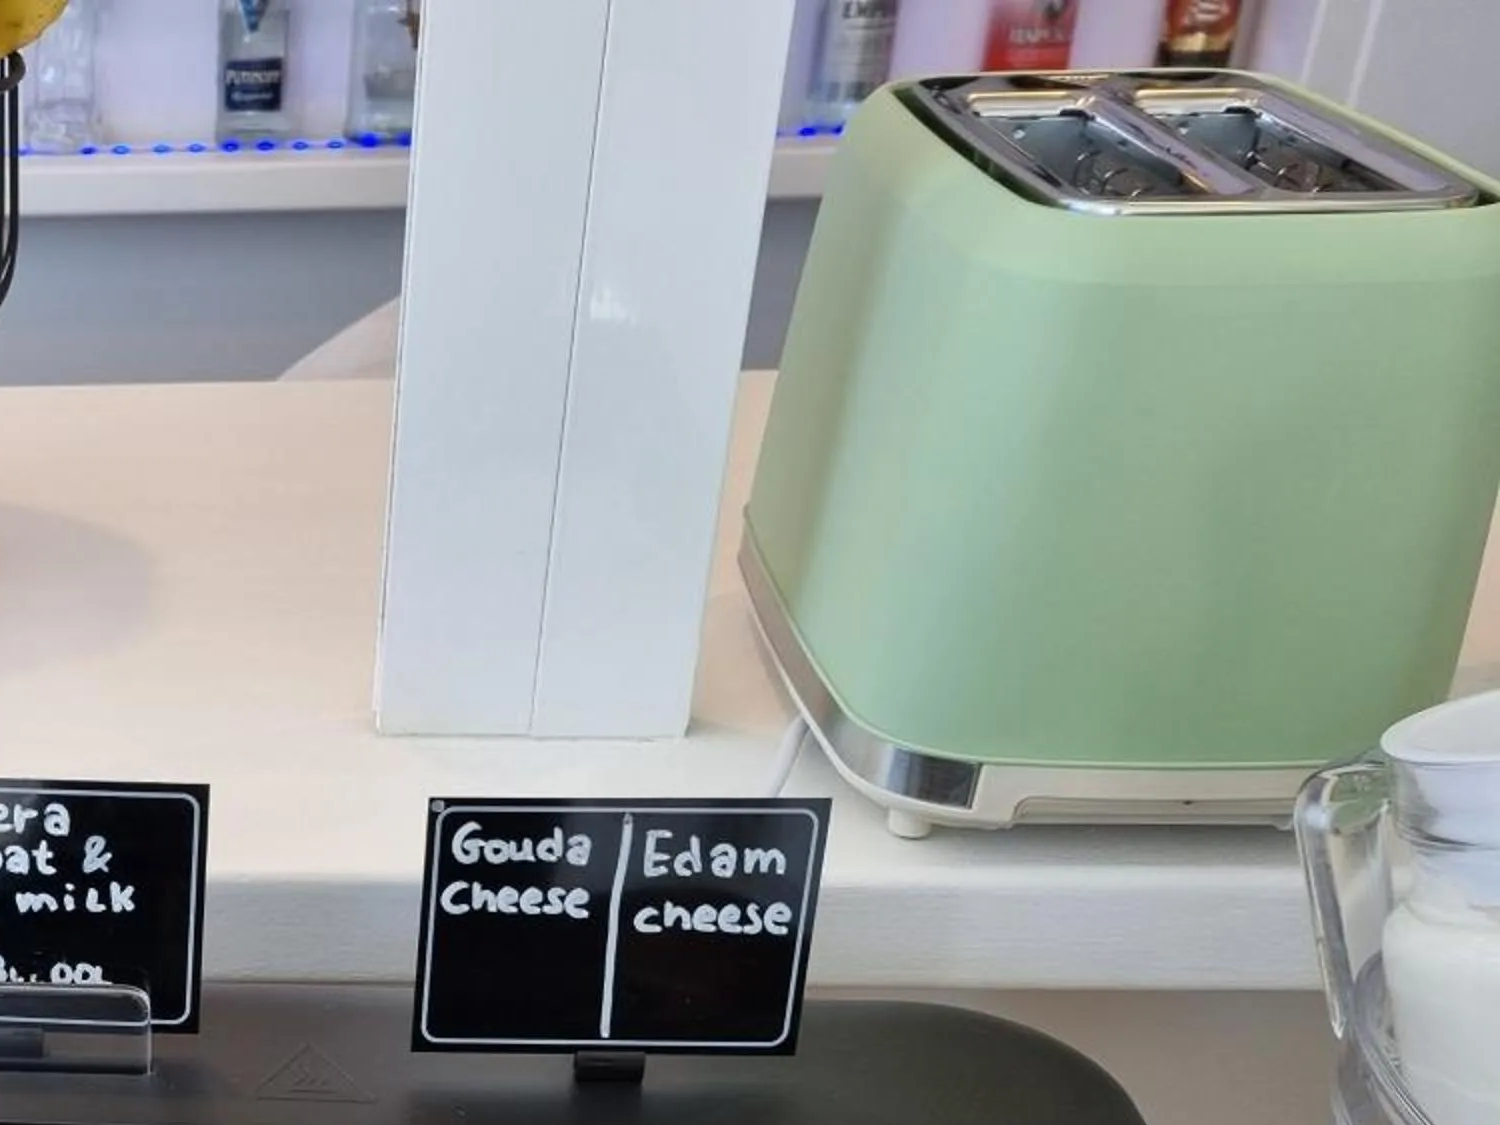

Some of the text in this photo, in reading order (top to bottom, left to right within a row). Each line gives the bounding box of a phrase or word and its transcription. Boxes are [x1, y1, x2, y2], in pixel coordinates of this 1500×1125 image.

[83, 835, 113, 874] &
[451, 821, 592, 867] Gouda
[643, 829, 787, 878] Edam
[15, 882, 136, 913] milk
